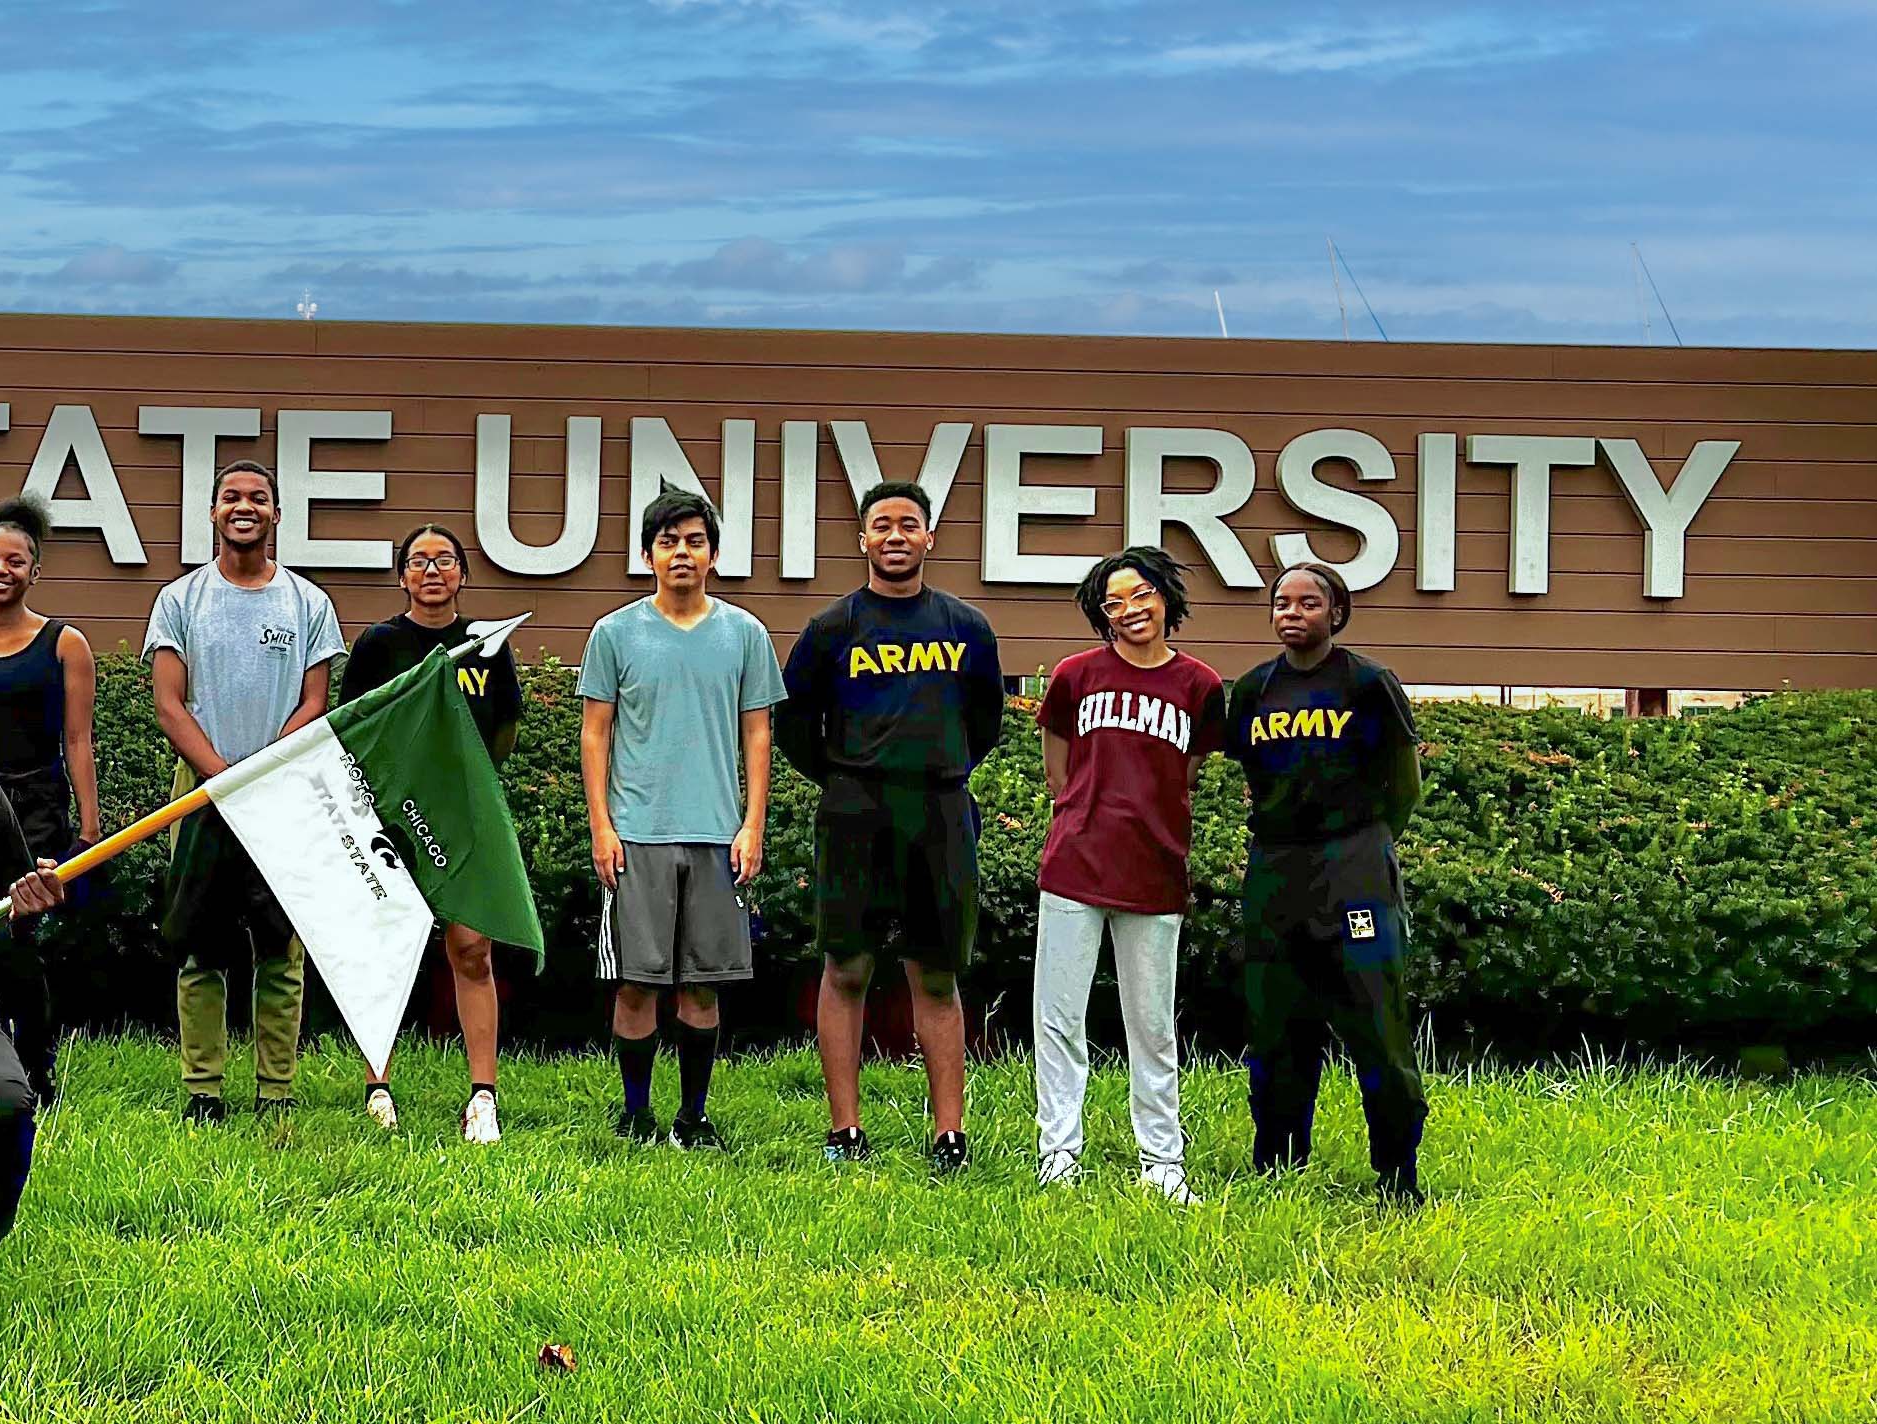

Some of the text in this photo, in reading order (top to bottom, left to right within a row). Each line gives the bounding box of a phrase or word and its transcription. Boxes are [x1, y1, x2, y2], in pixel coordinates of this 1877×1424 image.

[475, 413, 1743, 599] UNIVERSITY
[457, 667, 490, 697] MY
[848, 641, 966, 679] ARMY
[1077, 691, 1191, 754] HILLMAN
[1249, 707, 1353, 745] ARMY
[339, 752, 375, 807] ROTC
[402, 798, 448, 868] CHICAGO
[340, 834, 388, 900] STATE
